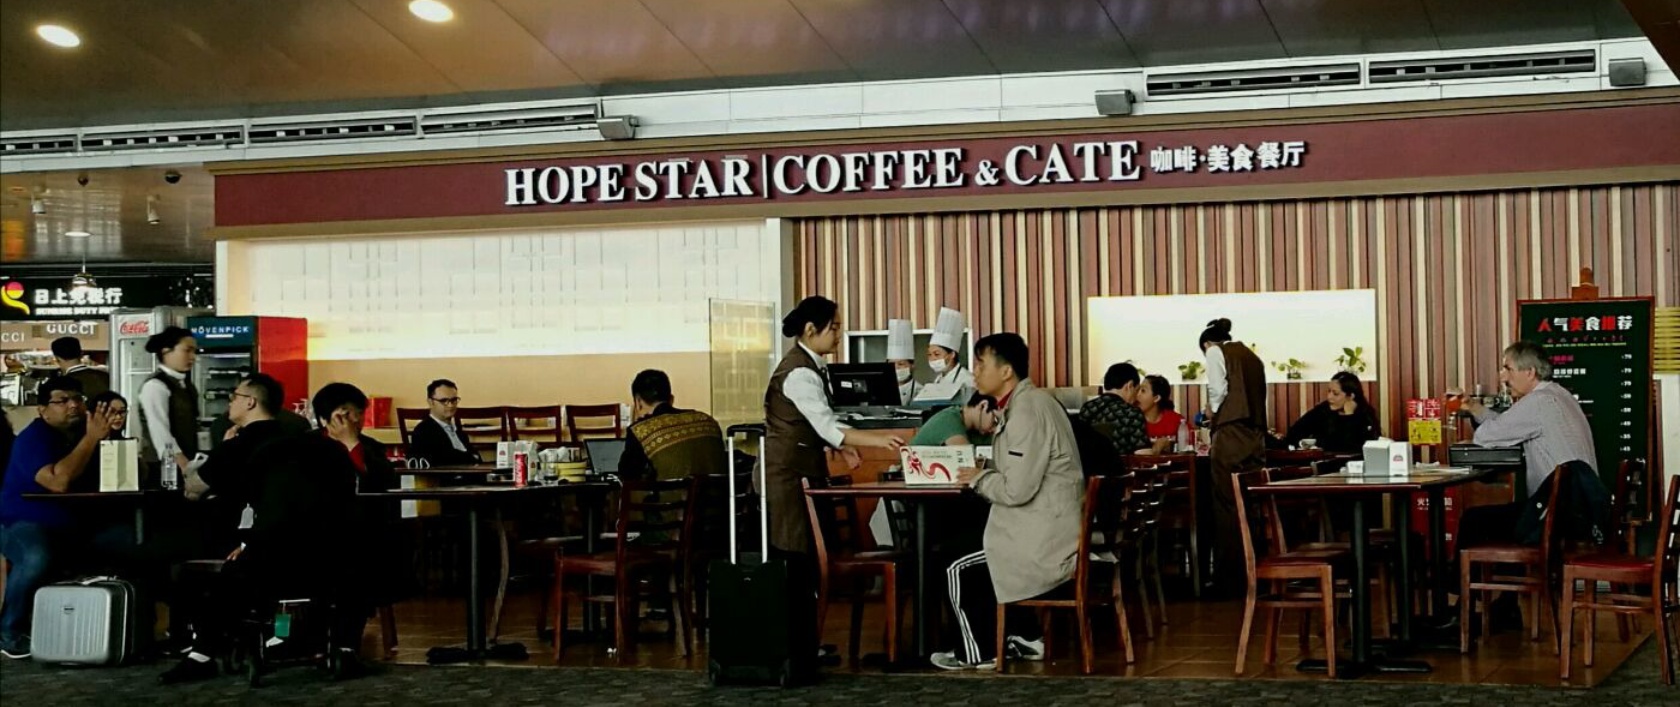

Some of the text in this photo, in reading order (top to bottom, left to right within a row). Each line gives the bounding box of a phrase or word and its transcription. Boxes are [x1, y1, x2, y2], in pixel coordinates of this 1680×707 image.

[504, 140, 1141, 206] HOPE STAR COFFEE & CATE
[46, 323, 96, 335] GUCCI
